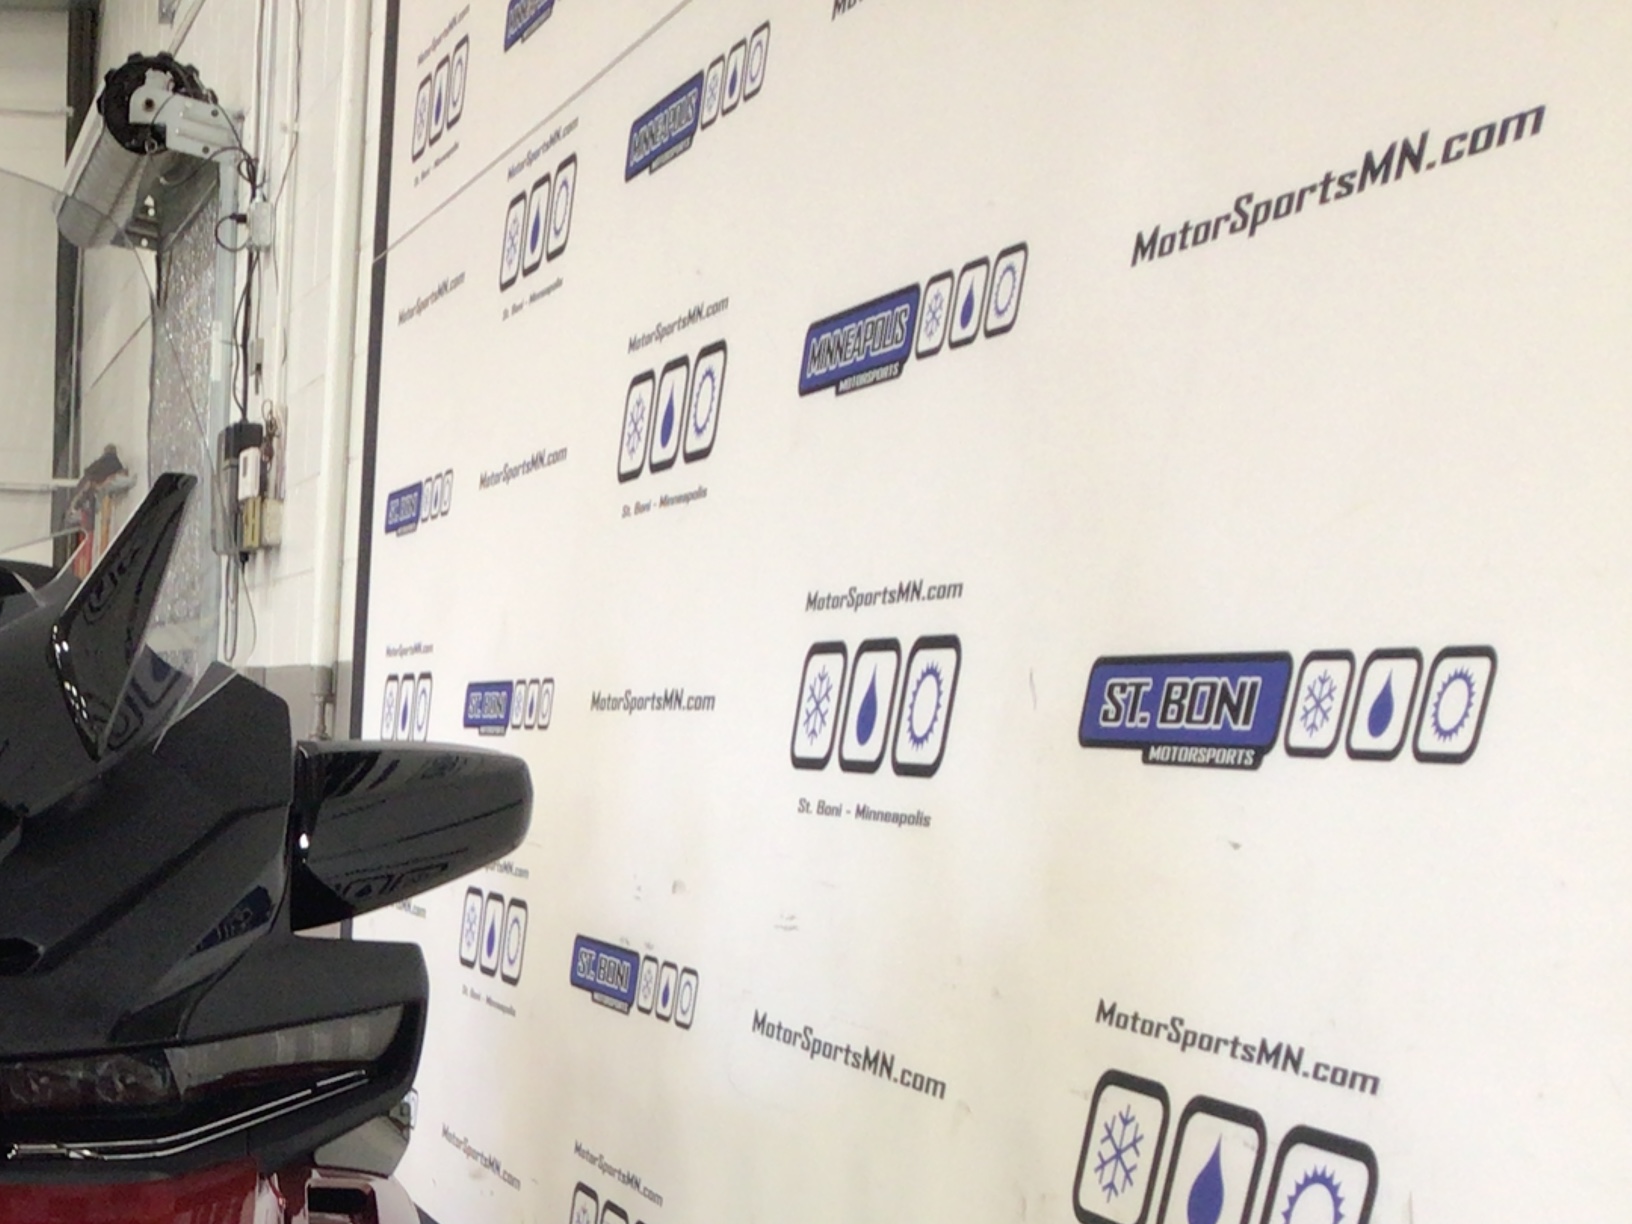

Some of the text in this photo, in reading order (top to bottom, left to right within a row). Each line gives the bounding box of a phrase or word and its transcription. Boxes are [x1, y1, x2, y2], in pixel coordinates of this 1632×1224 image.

[1130, 104, 1547, 268] MotorSportsMN.com
[628, 297, 729, 354] MotorSportsMN.com
[806, 303, 911, 378] MINNEAPOLIS
[838, 362, 900, 392] MOTORSPORTS
[479, 447, 567, 491] MotorSportsMN.com
[805, 579, 964, 613] MotorSportsMN.com
[590, 688, 716, 716] MotorSportsMN.com
[1099, 675, 1262, 732] ST. BONI
[1148, 745, 1256, 768] MOTORSPORTS
[798, 798, 813, 815] St.
[816, 800, 843, 818] Boni
[855, 803, 932, 828] Minneapolis
[576, 946, 632, 994] ST. BONI
[752, 1009, 947, 1100] MotorSportsMN.com
[1095, 998, 1381, 1095] MotorSportsMN.com
[574, 1140, 664, 1208] MotorSportsMN.com
